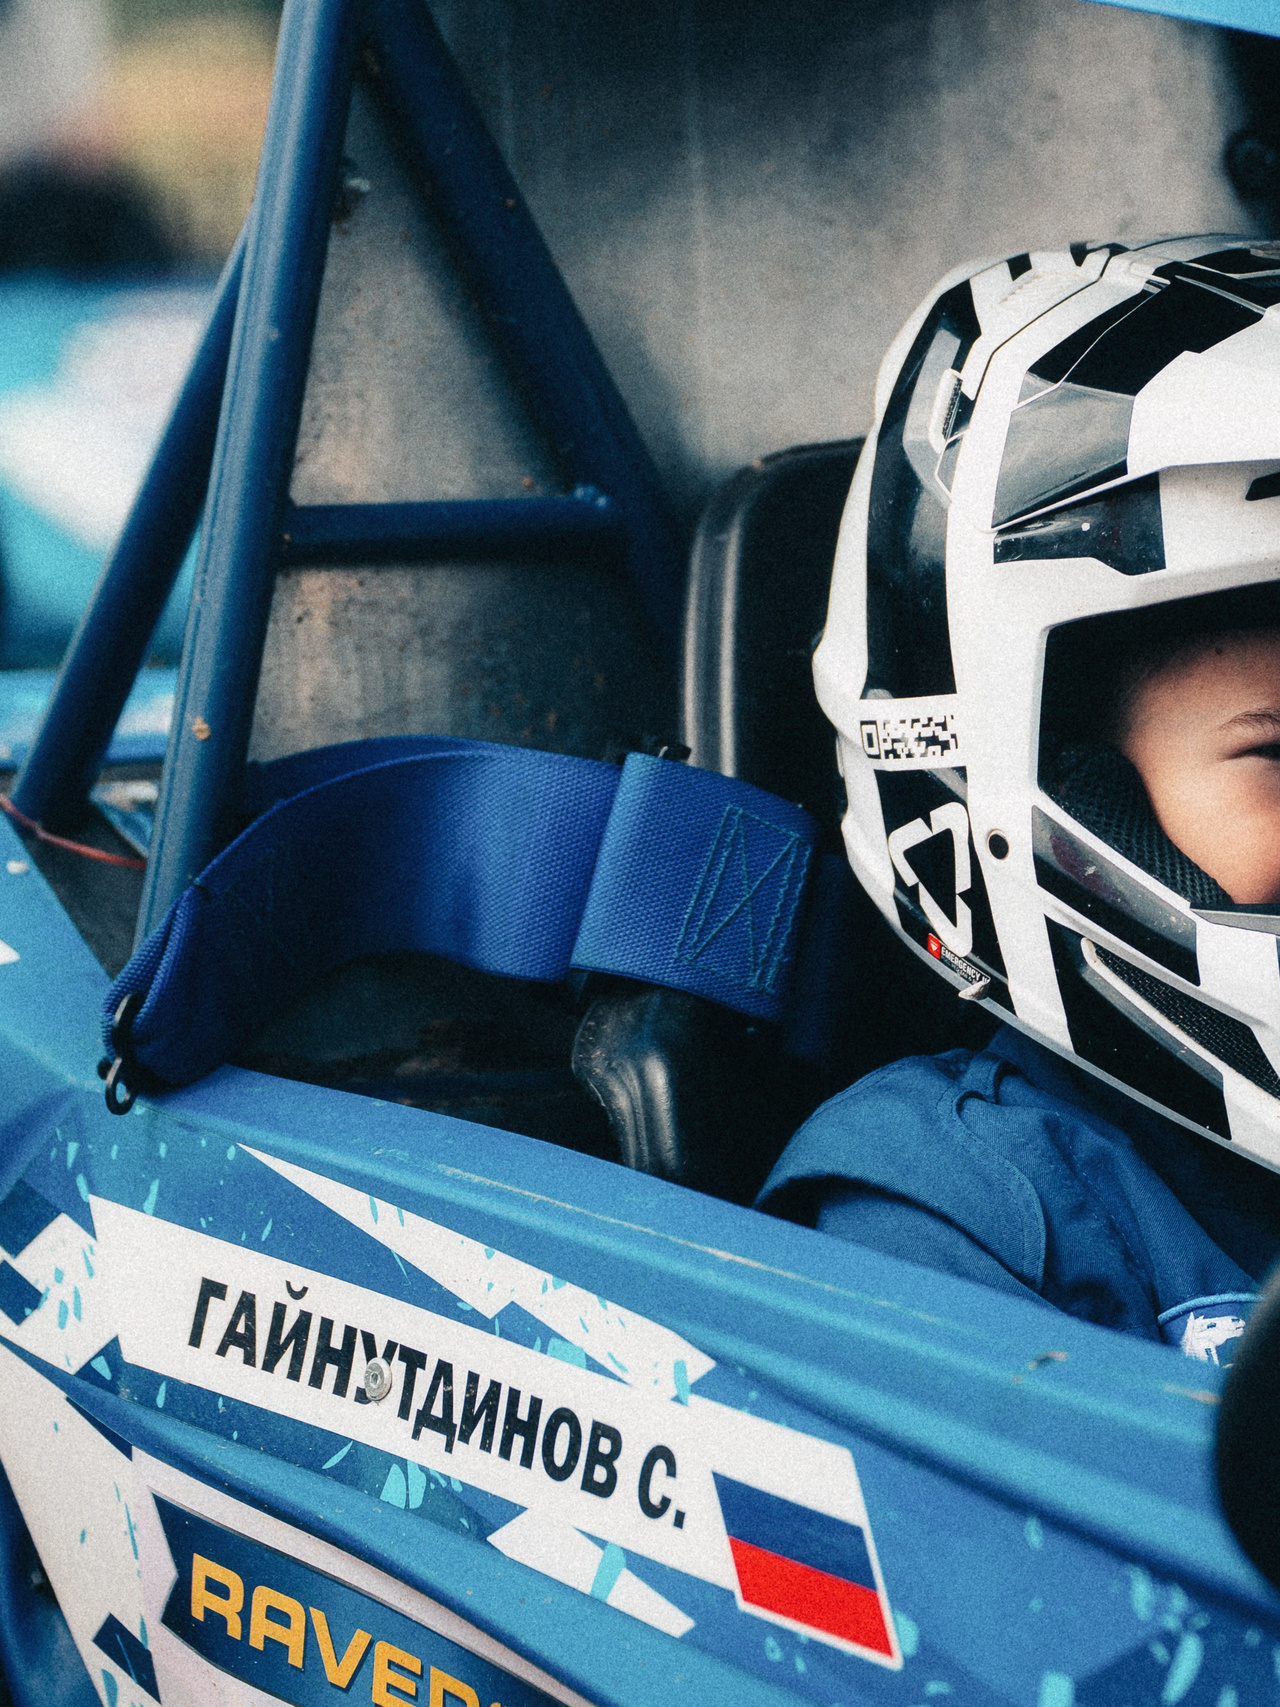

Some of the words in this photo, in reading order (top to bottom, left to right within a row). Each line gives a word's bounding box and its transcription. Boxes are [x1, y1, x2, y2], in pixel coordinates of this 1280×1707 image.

[940, 946, 981, 981] EMERGENCY
[188, 1276, 620, 1498] ГАЙНУТДИНОВ
[637, 1443, 688, 1530] С.
